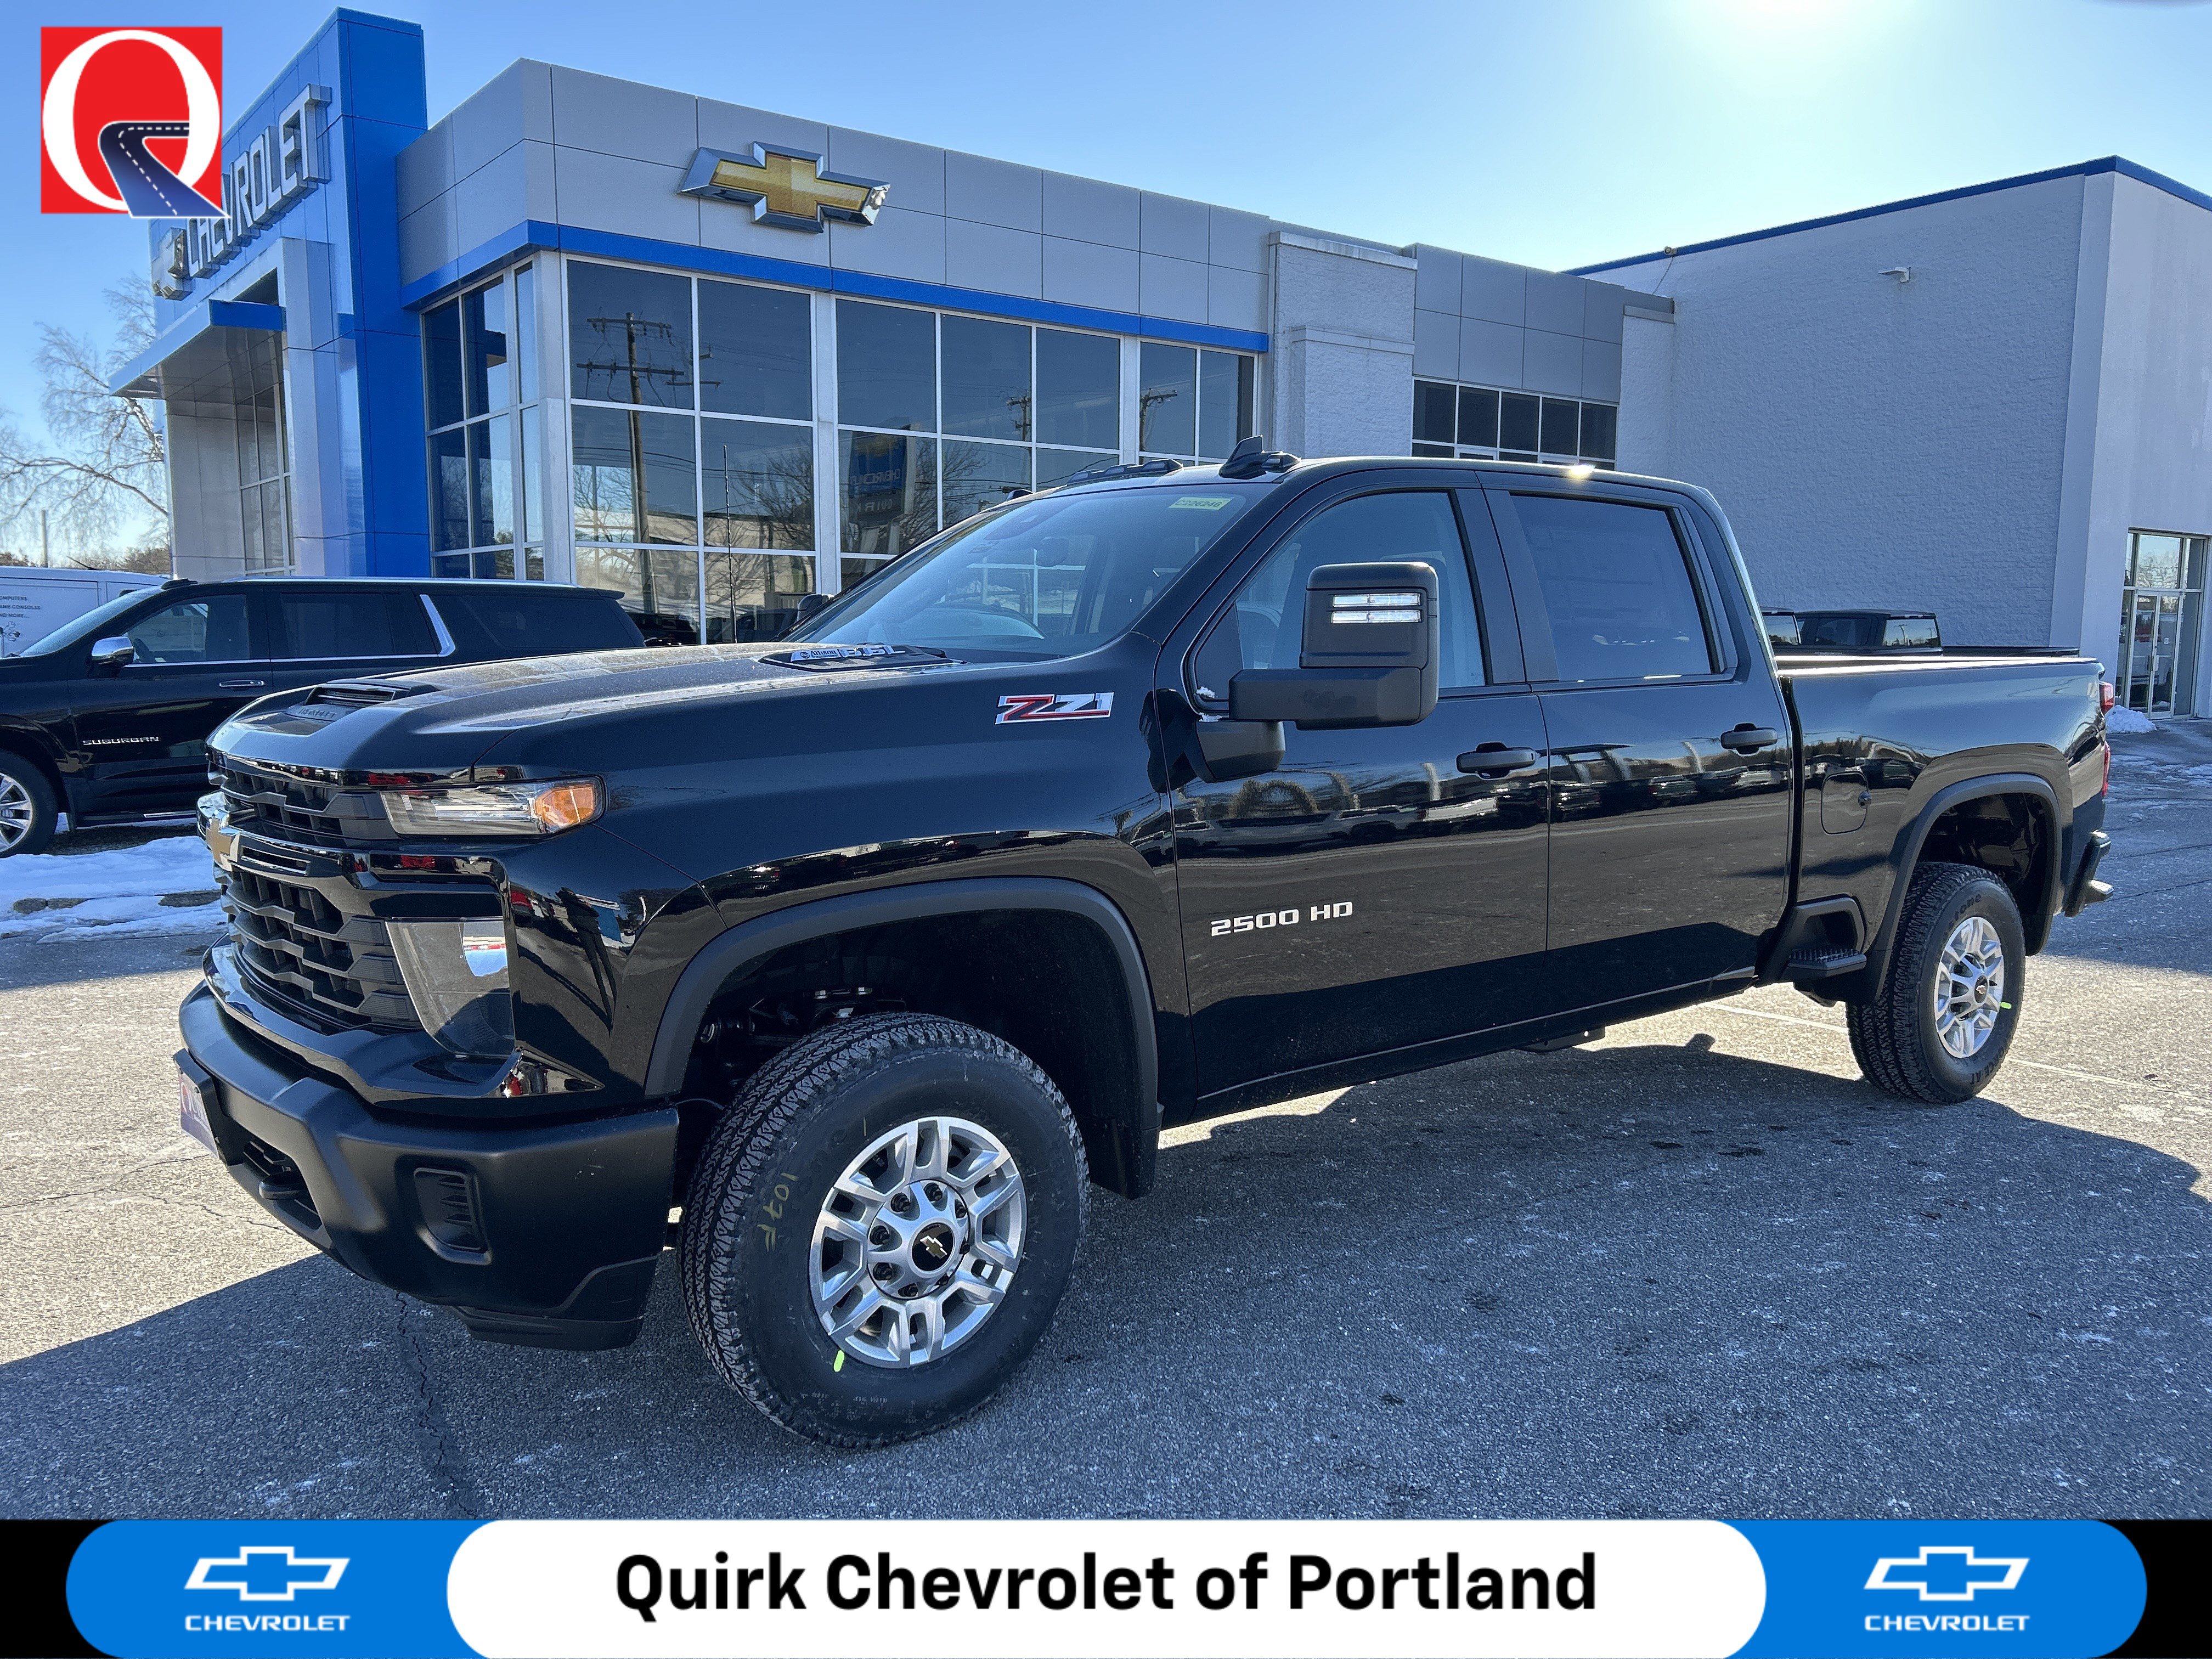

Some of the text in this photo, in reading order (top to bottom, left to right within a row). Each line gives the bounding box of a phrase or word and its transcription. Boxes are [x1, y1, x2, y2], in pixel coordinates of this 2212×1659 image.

[995, 692, 1114, 725] Z71
[82, 736, 159, 746] SUBURBAN
[1211, 901, 1353, 936] 2500 HD
